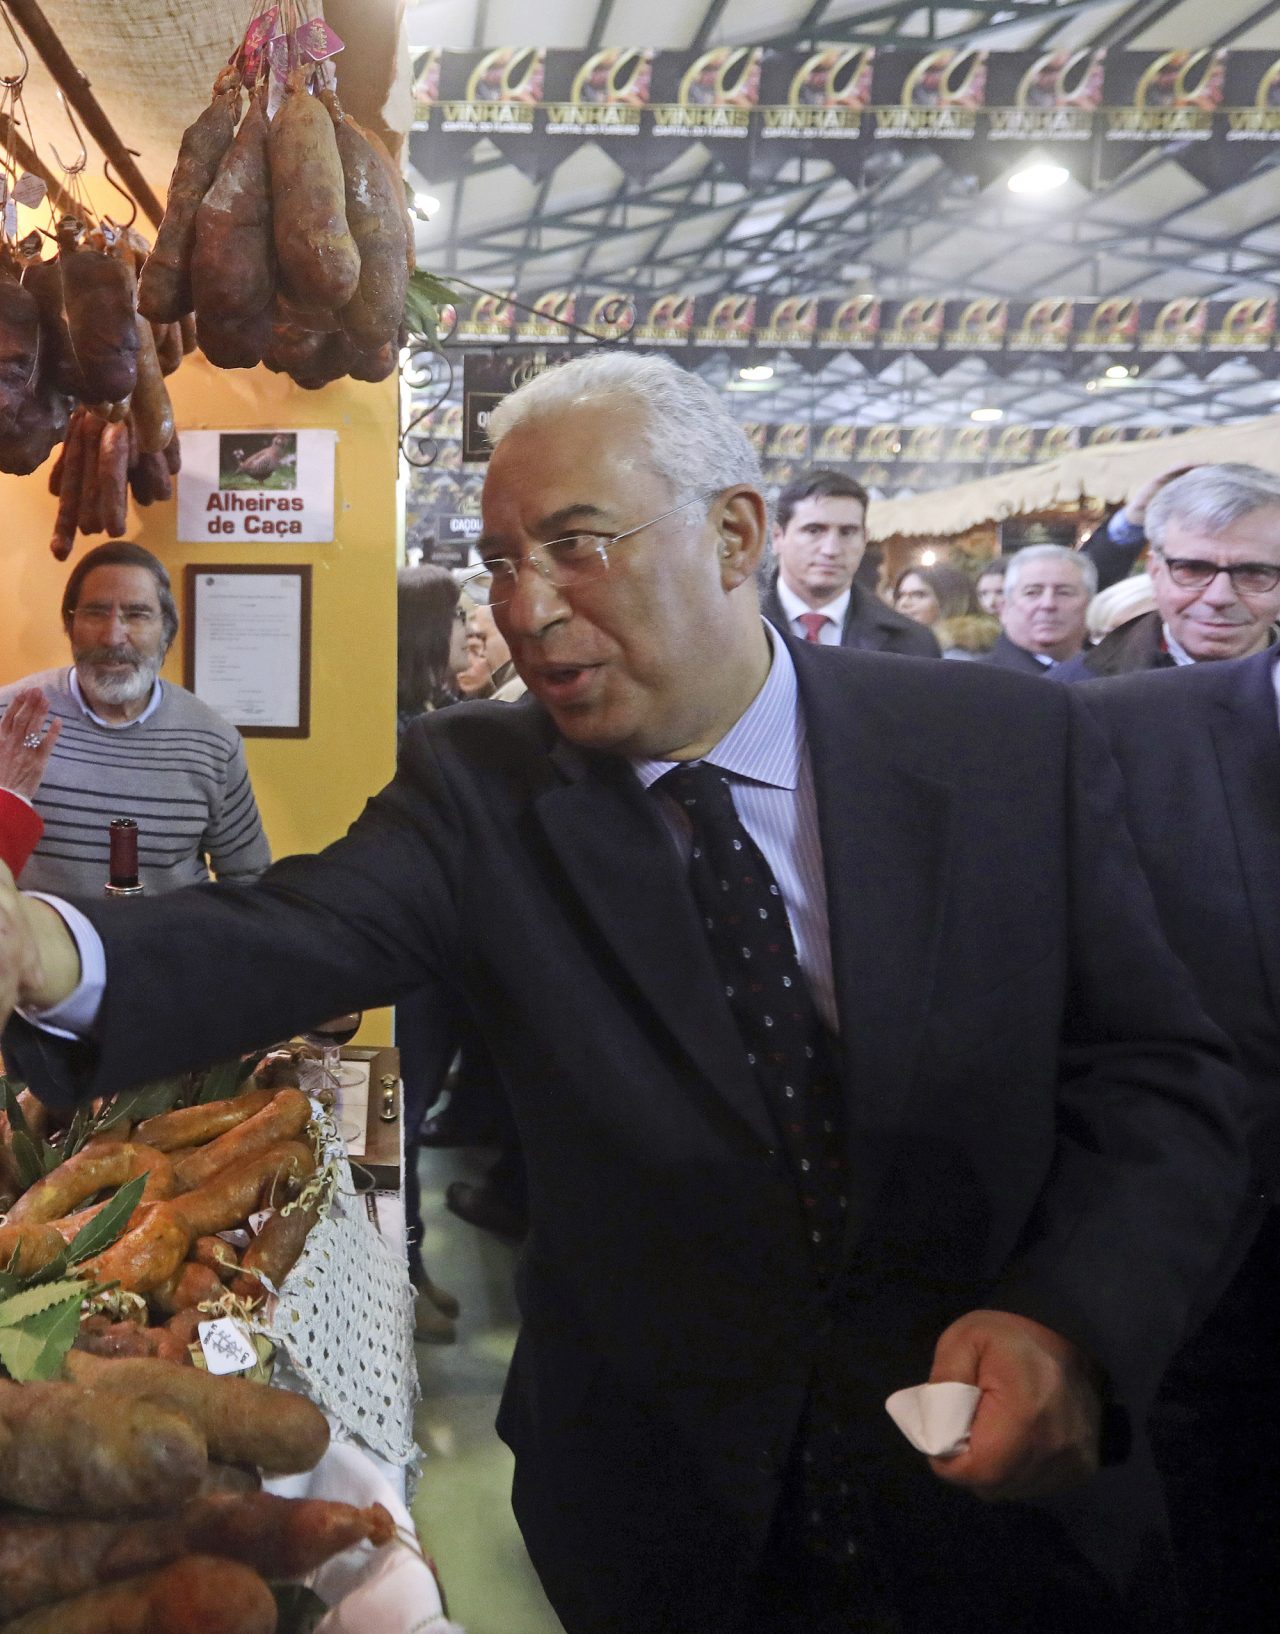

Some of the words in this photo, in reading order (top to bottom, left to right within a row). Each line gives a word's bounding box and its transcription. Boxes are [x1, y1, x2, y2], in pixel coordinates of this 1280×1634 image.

[206, 493, 304, 512] Alheiras
[208, 515, 234, 534] de
[244, 515, 302, 538] Caça
